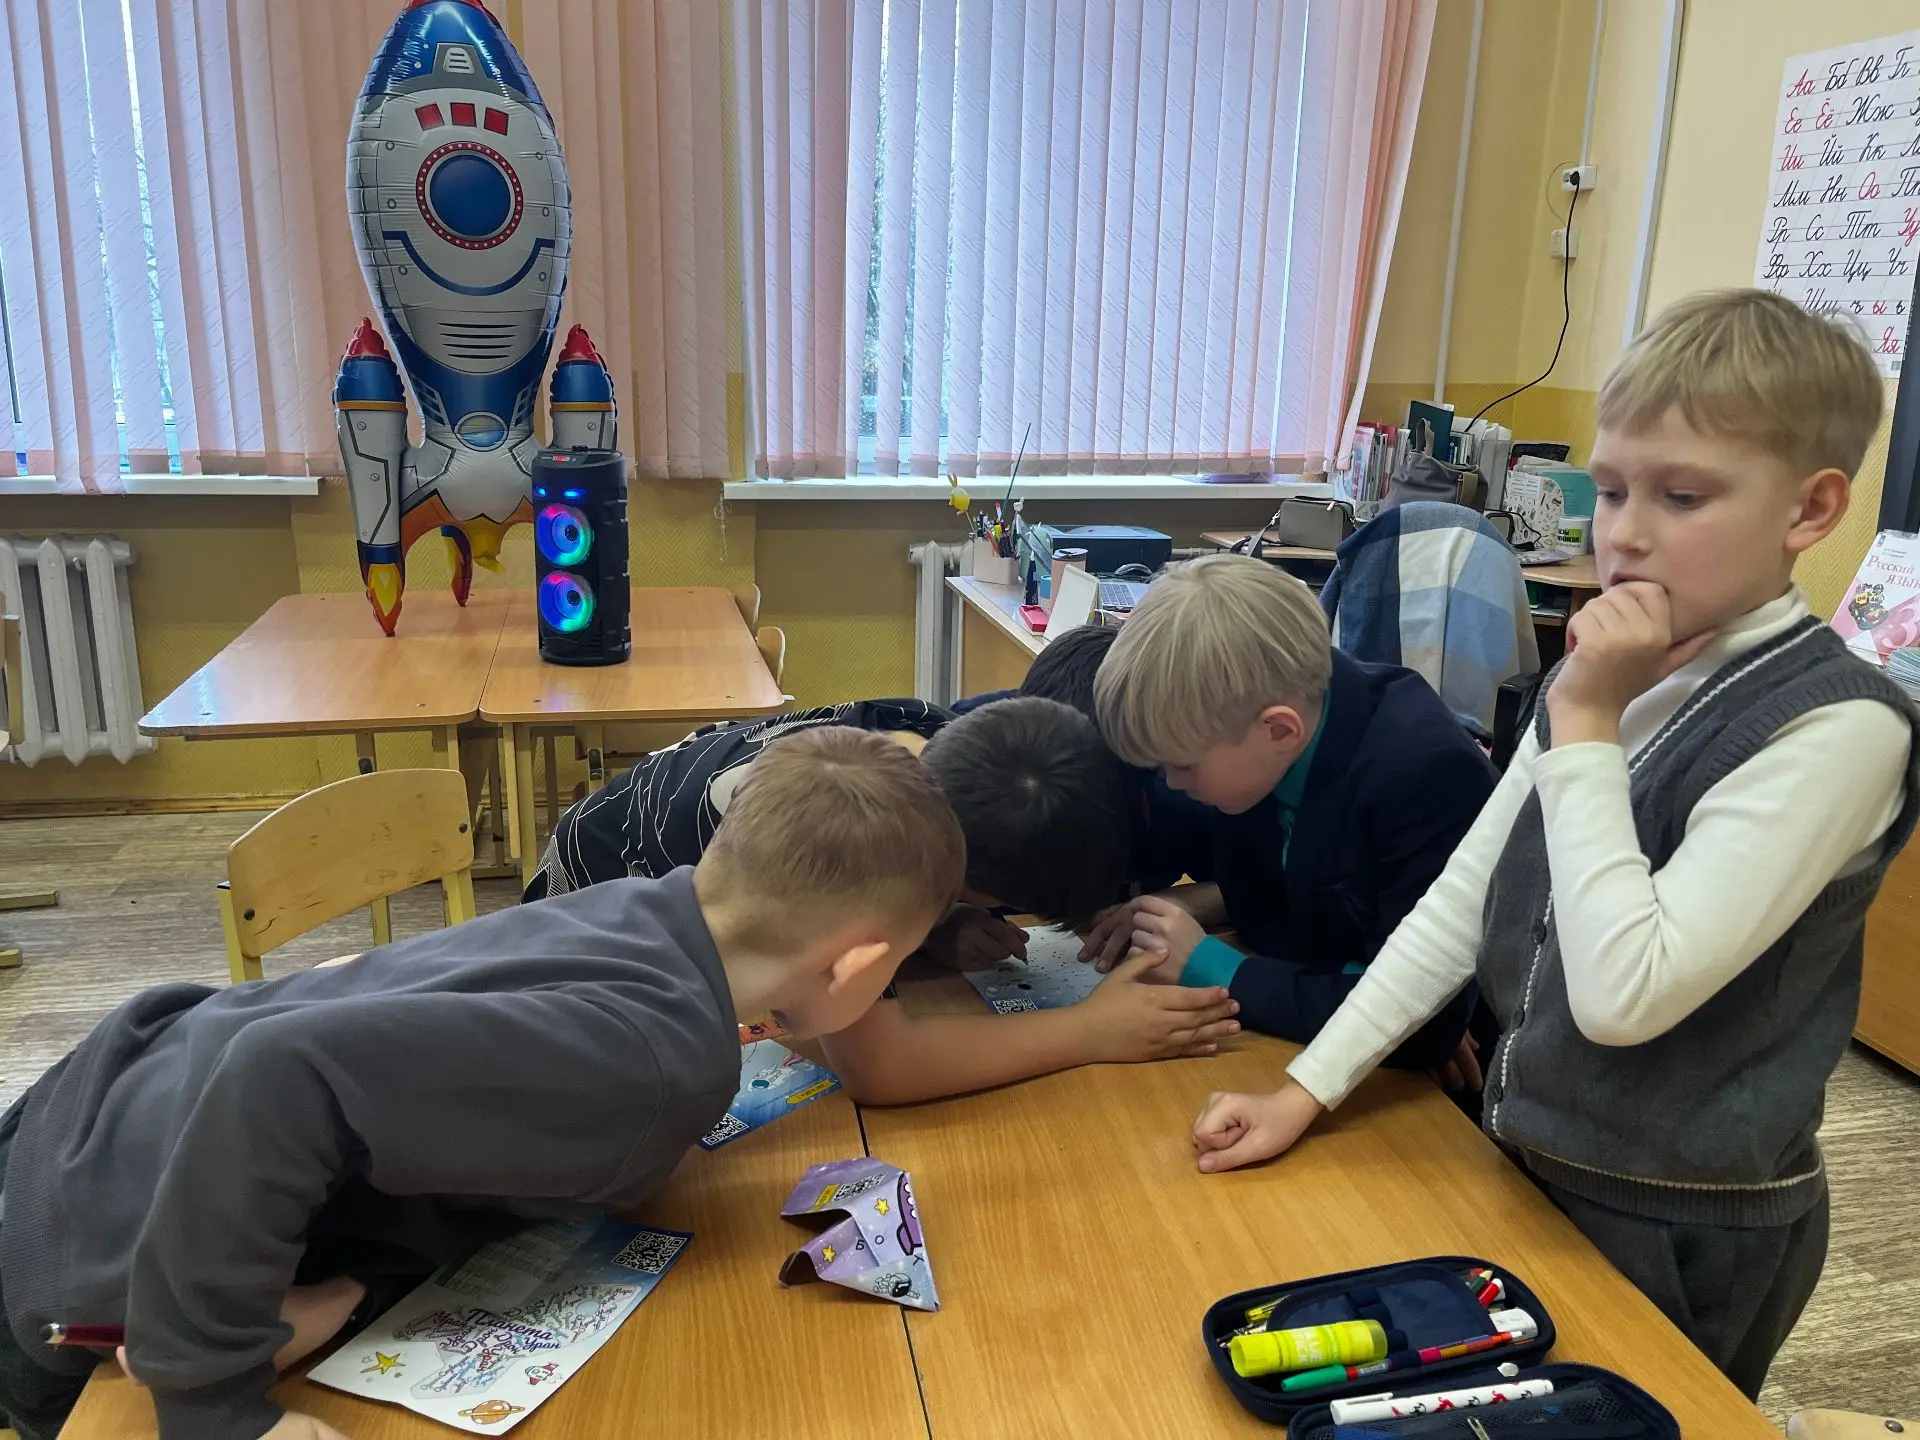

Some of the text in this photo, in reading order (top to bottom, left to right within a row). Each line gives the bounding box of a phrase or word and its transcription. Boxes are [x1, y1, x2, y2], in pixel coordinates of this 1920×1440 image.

[1786, 68, 1816, 98] Аа
[1825, 57, 1860, 91] Бб
[1855, 54, 1880, 87] Вв
[1784, 106, 1802, 134] Ее
[1815, 97, 1834, 130] Ёё
[1845, 95, 1895, 125] Жж
[1781, 143, 1805, 170] Ии
[1819, 132, 1845, 167] Йй
[1859, 132, 1886, 162] Кк
[1773, 179, 1810, 207] Мм
[1819, 175, 1847, 202] Нн
[1857, 171, 1880, 200] Оо
[1767, 217, 1791, 251] Рр
[1805, 214, 1824, 240] Сс
[1840, 210, 1880, 239] Тт
[1763, 247, 1909, 289] Фф Хх Цц Чч
[1874, 326, 1901, 354] Яя
[1867, 554, 1915, 575] Русский
[855, 1239, 865, 1251] Б
[465, 1307, 554, 1341] Планета
[524, 1335, 562, 1353] Уран
